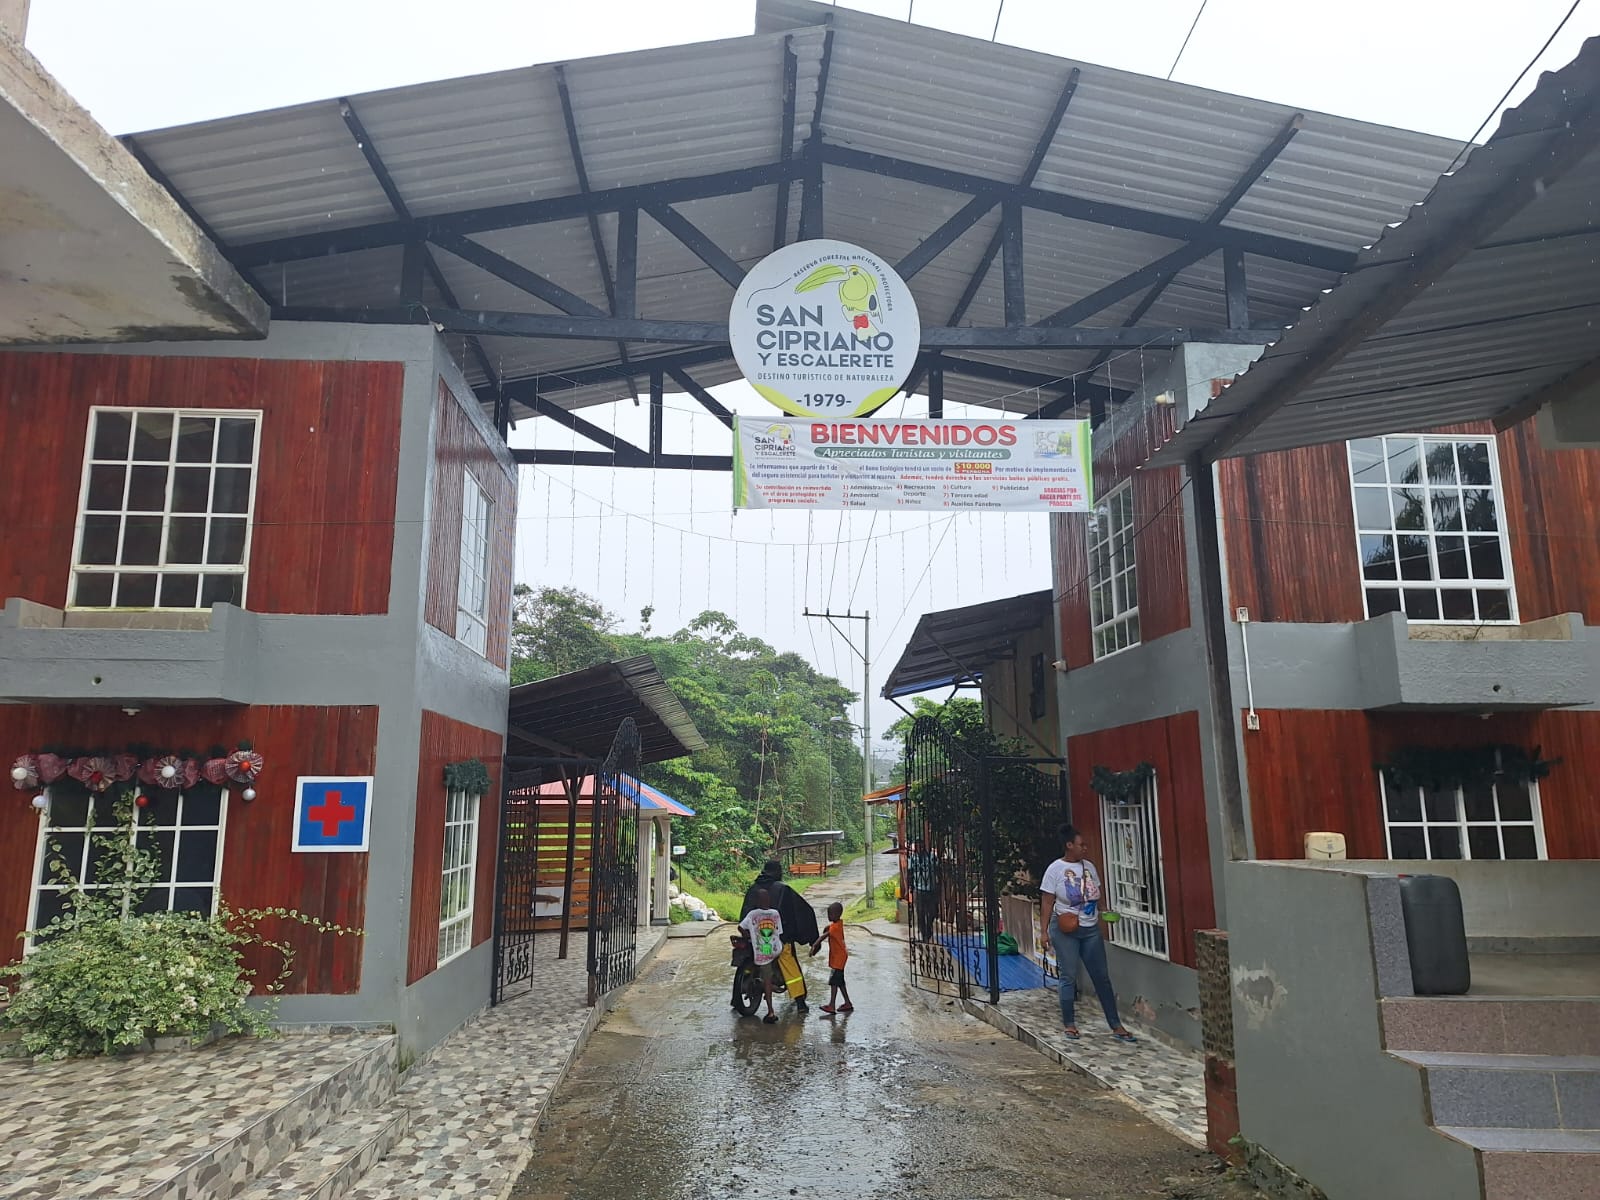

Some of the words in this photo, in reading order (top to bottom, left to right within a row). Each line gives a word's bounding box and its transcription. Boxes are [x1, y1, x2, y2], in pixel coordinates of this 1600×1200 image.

[819, 254, 850, 262] FORESTAL
[852, 255, 881, 272] NACIONAL
[756, 304, 823, 327] SAN
[756, 330, 894, 351] CIPRIANO
[758, 353, 772, 367] Y
[777, 353, 894, 368] ESCALERETE
[758, 372, 790, 380] DESTINO
[846, 374, 895, 382] NATURALEZA
[811, 423, 1017, 446] BIENVENIDOS
[823, 449, 887, 459] Apreciados
[892, 449, 936, 458] Turistas
[939, 451, 947, 460] y
[950, 450, 1003, 458] visitantes
